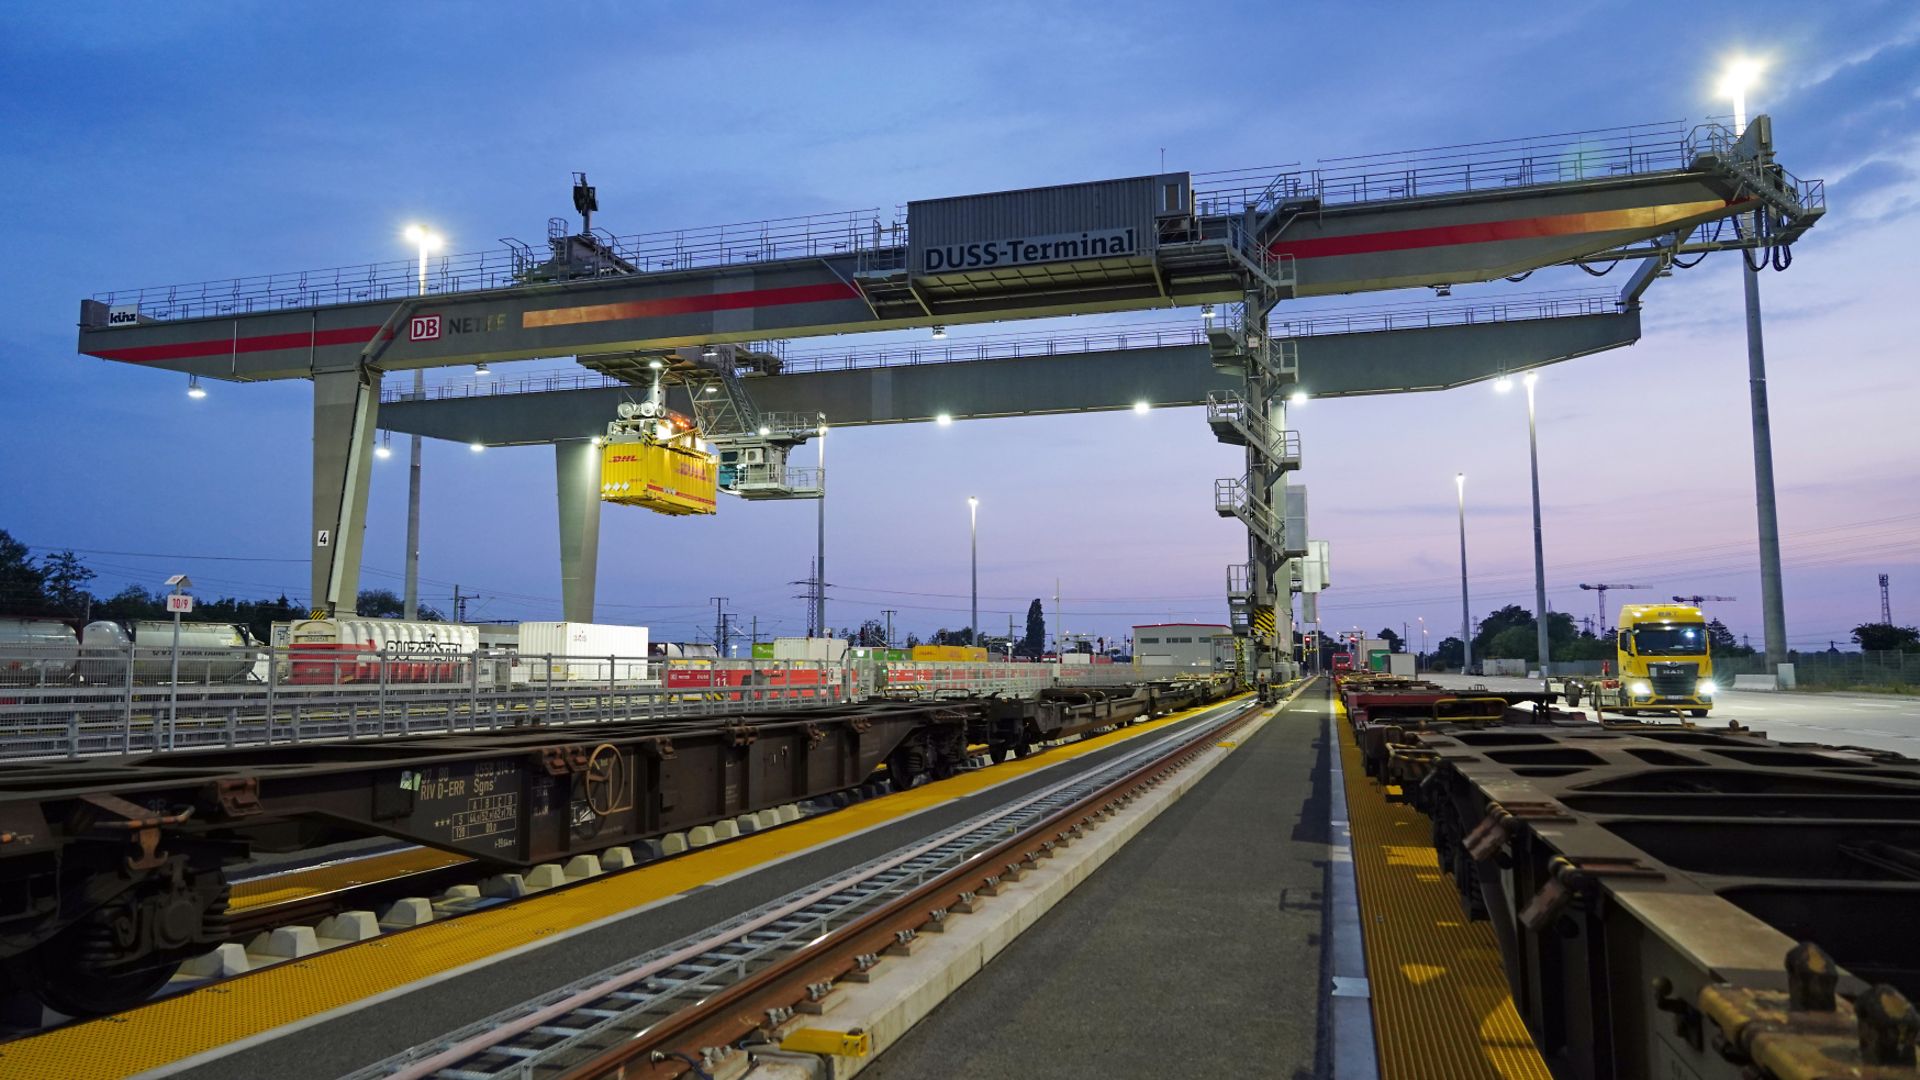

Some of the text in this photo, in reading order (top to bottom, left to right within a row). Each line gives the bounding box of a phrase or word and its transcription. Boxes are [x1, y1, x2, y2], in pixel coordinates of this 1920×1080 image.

[925, 229, 1133, 270] DUSS-Terminal
[412, 318, 439, 339] DB
[319, 531, 327, 544] 4
[421, 778, 494, 800] RIV D-ERR Sgns
